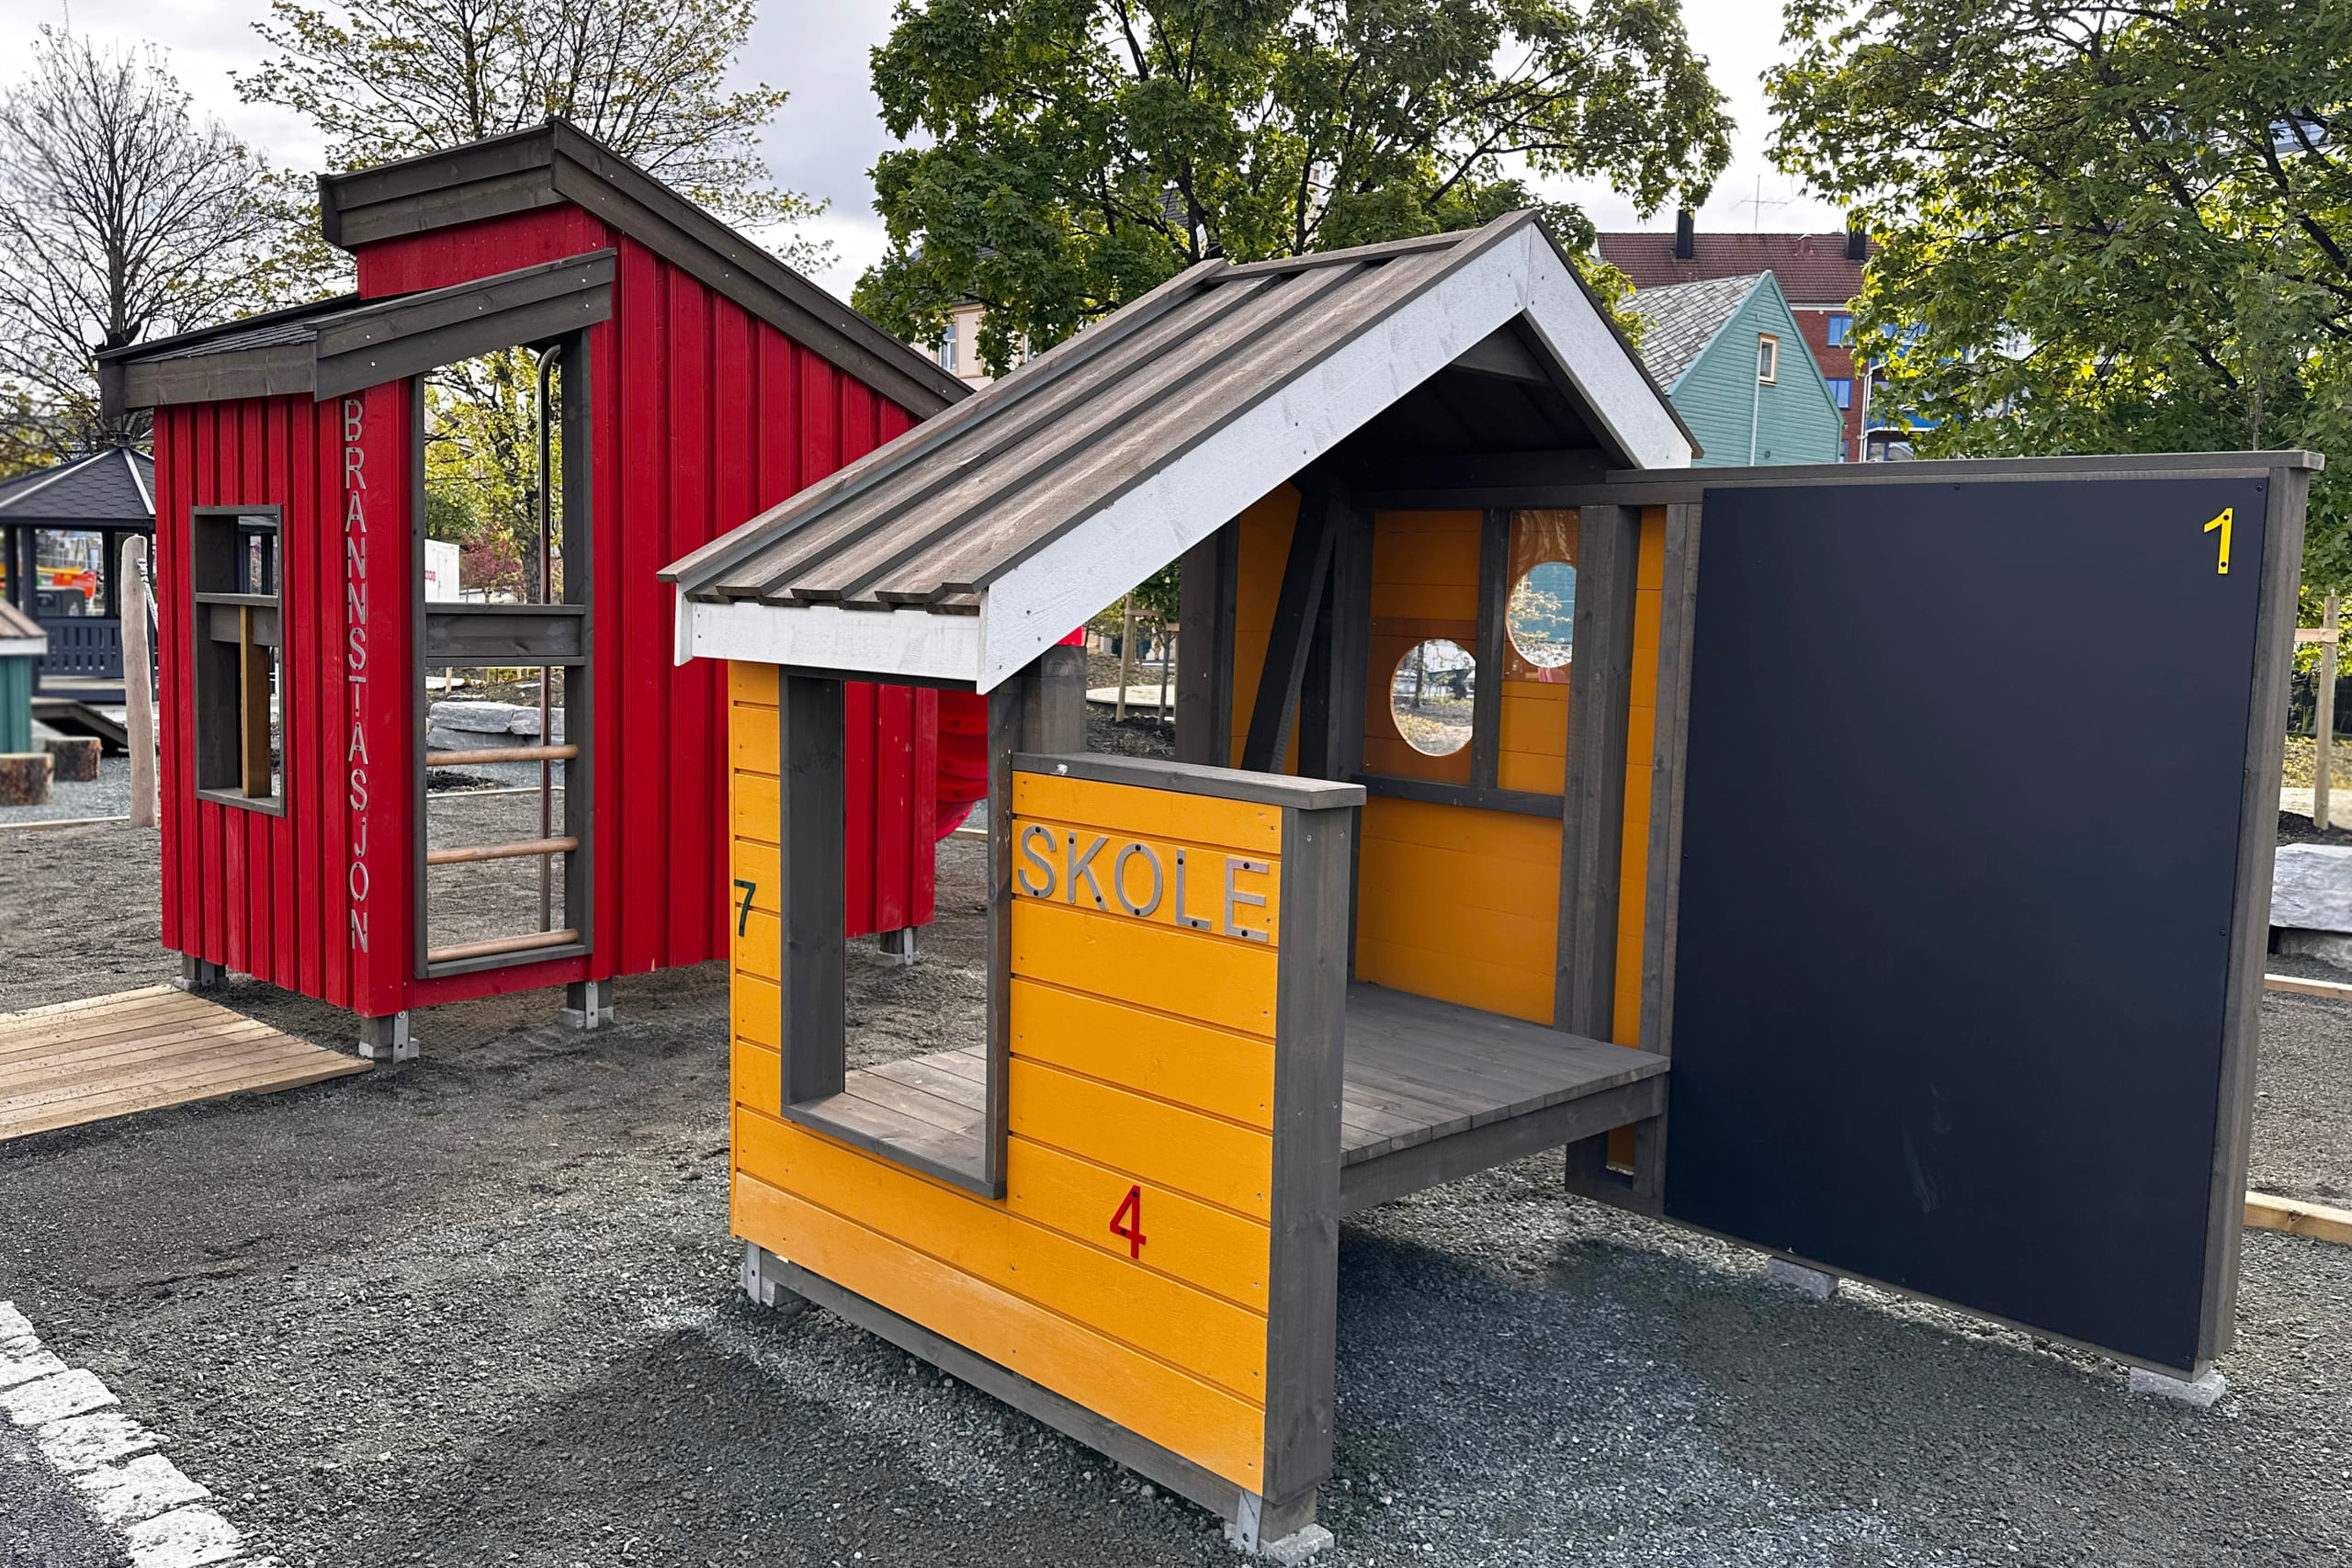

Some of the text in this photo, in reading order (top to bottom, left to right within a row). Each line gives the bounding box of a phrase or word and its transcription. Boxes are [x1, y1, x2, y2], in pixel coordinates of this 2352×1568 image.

[2204, 507, 2233, 574] 1
[345, 399, 369, 953] BRANNSTASJON
[733, 878, 756, 937] 7
[1018, 825, 1269, 942] SKOLE
[1109, 1184, 1147, 1259] 4
